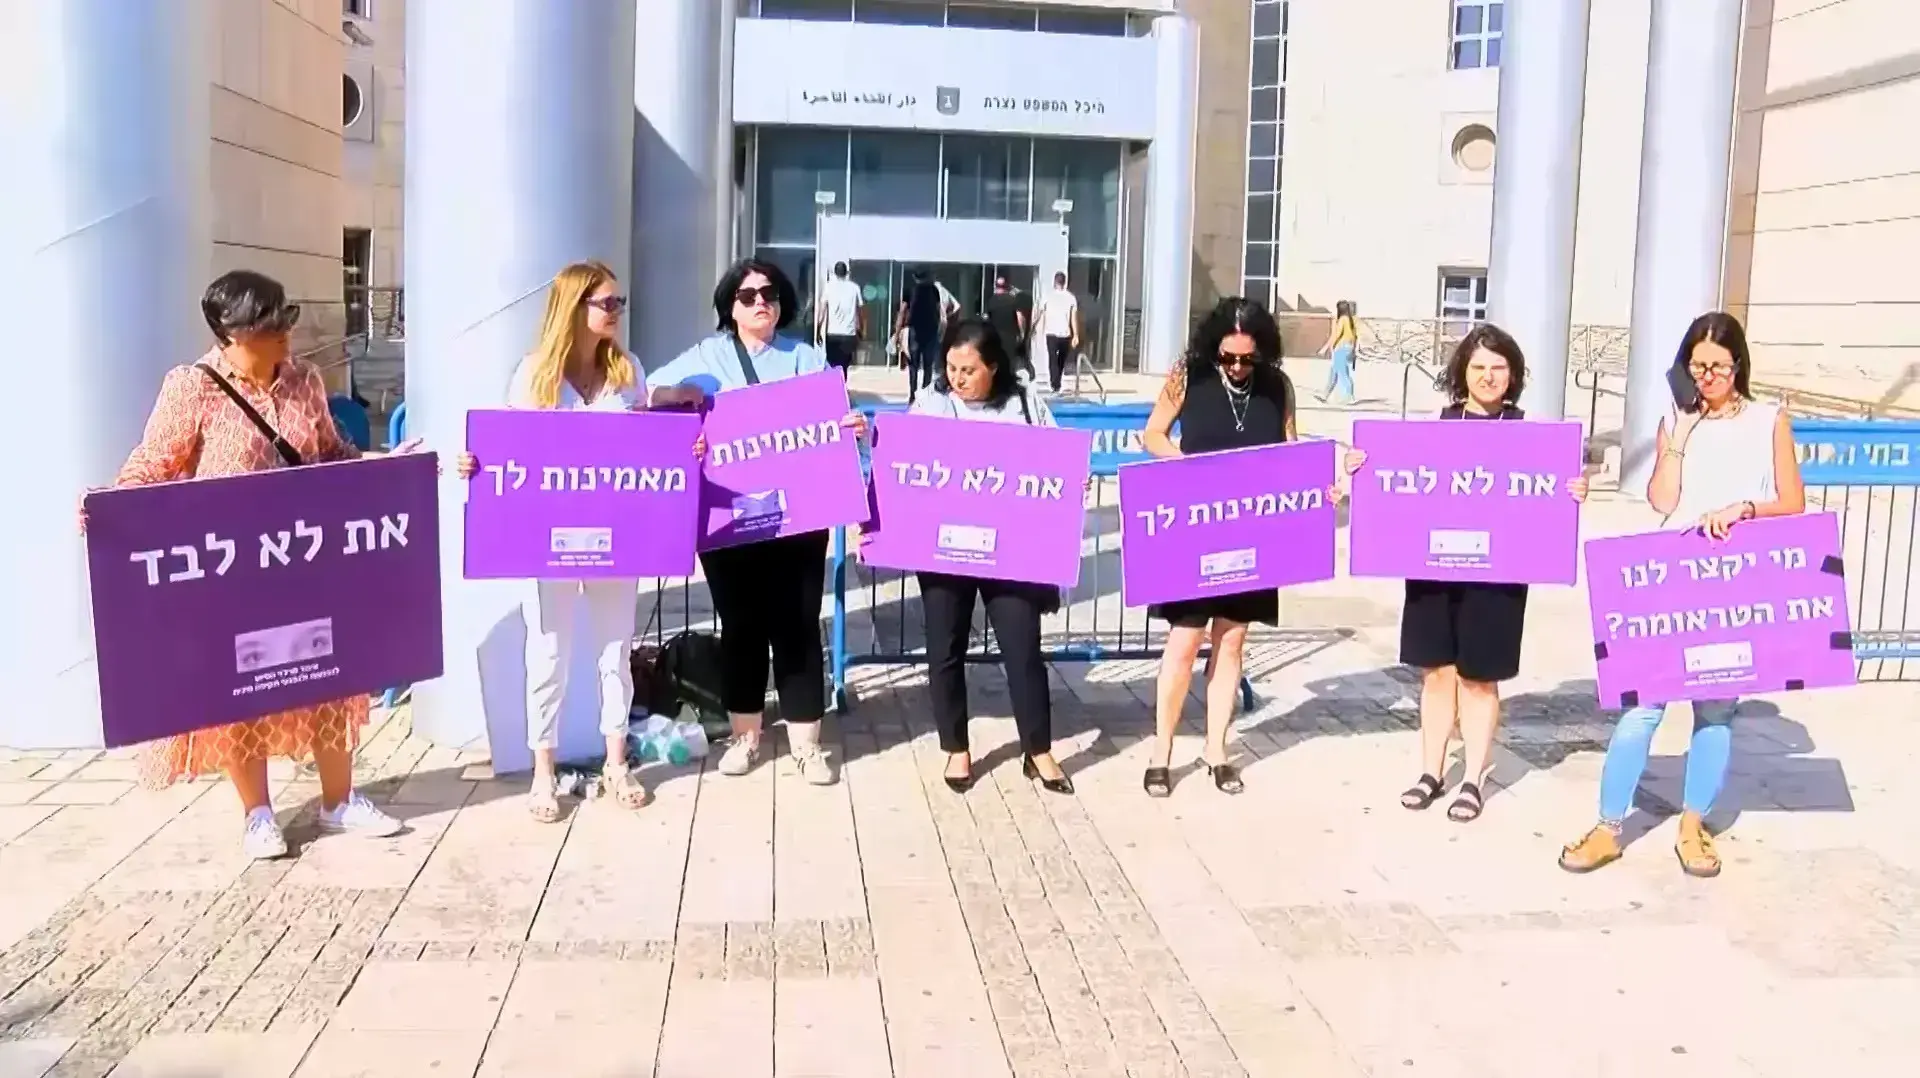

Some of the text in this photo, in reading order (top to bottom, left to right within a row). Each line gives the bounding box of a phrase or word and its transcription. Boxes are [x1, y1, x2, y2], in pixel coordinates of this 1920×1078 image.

[983, 96, 1105, 114] היכל המשפט נצרת
[712, 420, 840, 466] מאמינות
[484, 460, 685, 496] מאמינות לך
[892, 460, 1063, 499] את לא לבד
[1375, 466, 1556, 496] את לא לבד
[1137, 488, 1322, 536] מאמינות לך
[130, 514, 409, 585] את לא לבד
[1621, 548, 1806, 587] מי יקצר לנו
[1605, 596, 1833, 639] את הטראומה?
